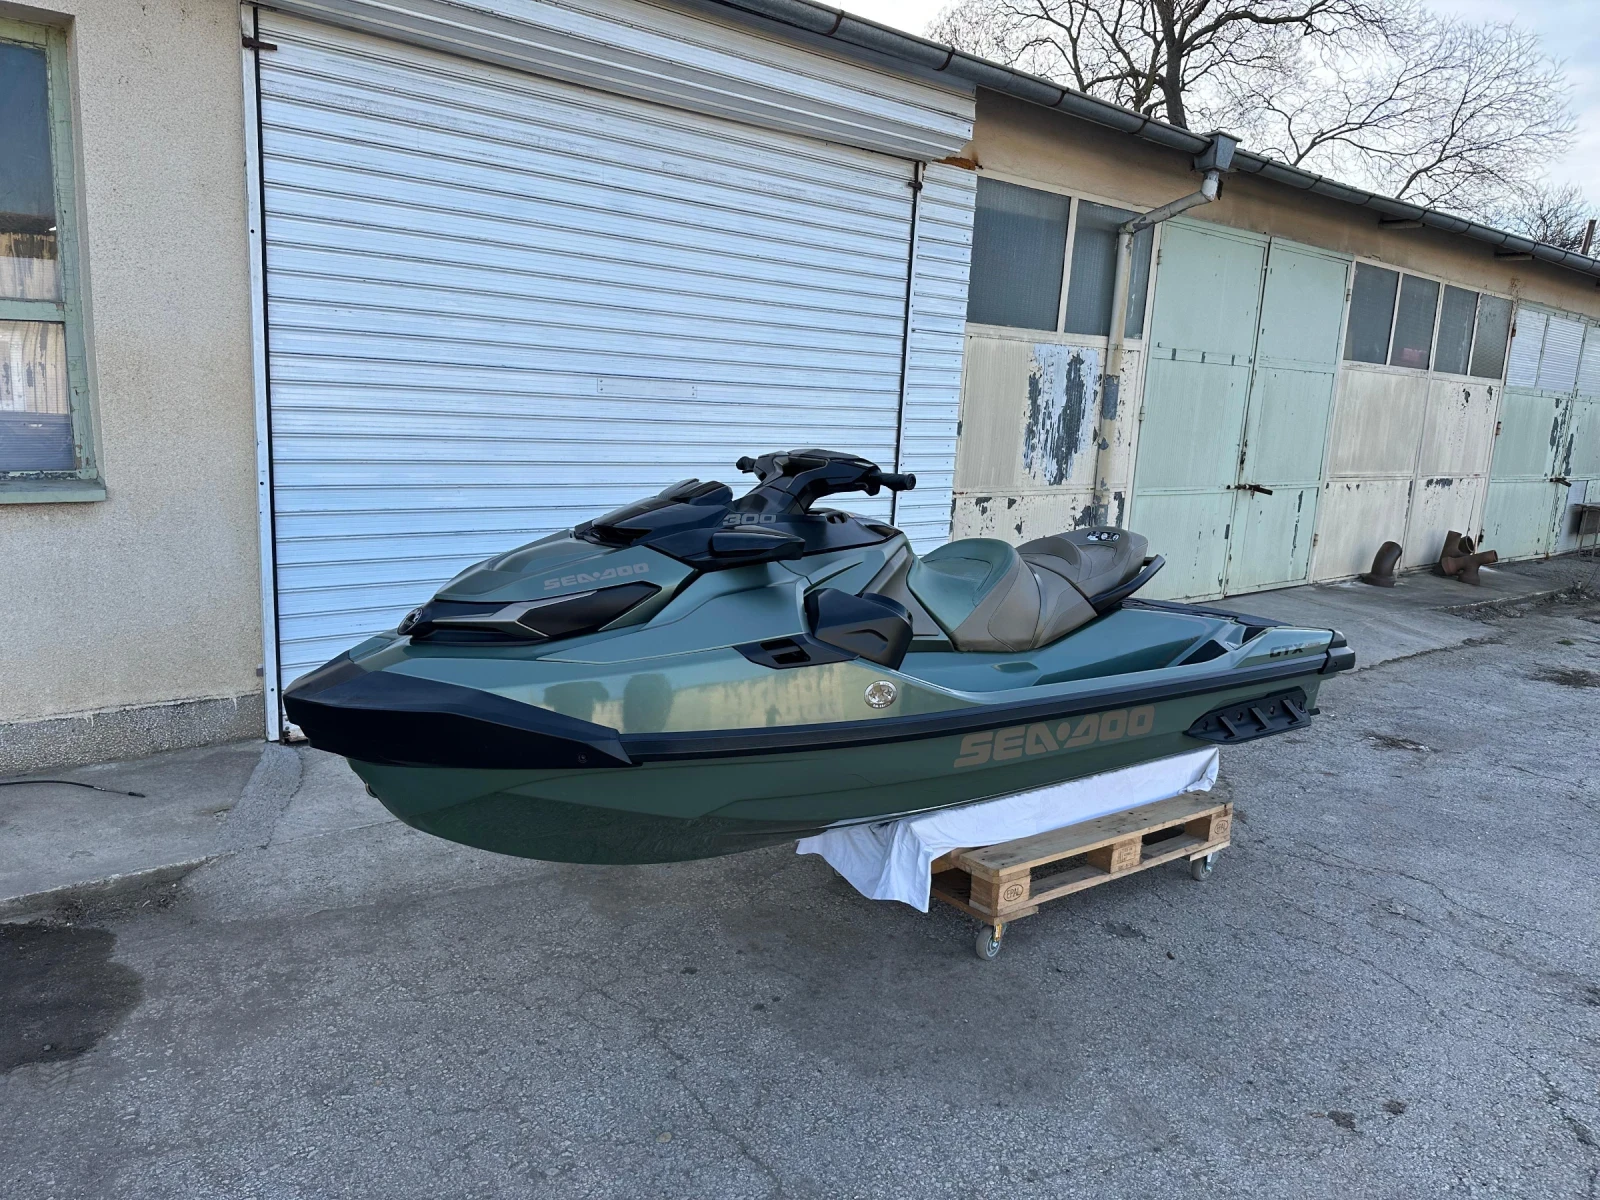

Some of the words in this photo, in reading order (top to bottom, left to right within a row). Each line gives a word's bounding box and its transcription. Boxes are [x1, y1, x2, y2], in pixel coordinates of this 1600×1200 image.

[723, 514, 777, 526] 300
[1270, 642, 1303, 658] GTX
[1006, 886, 1021, 899] EPAL
